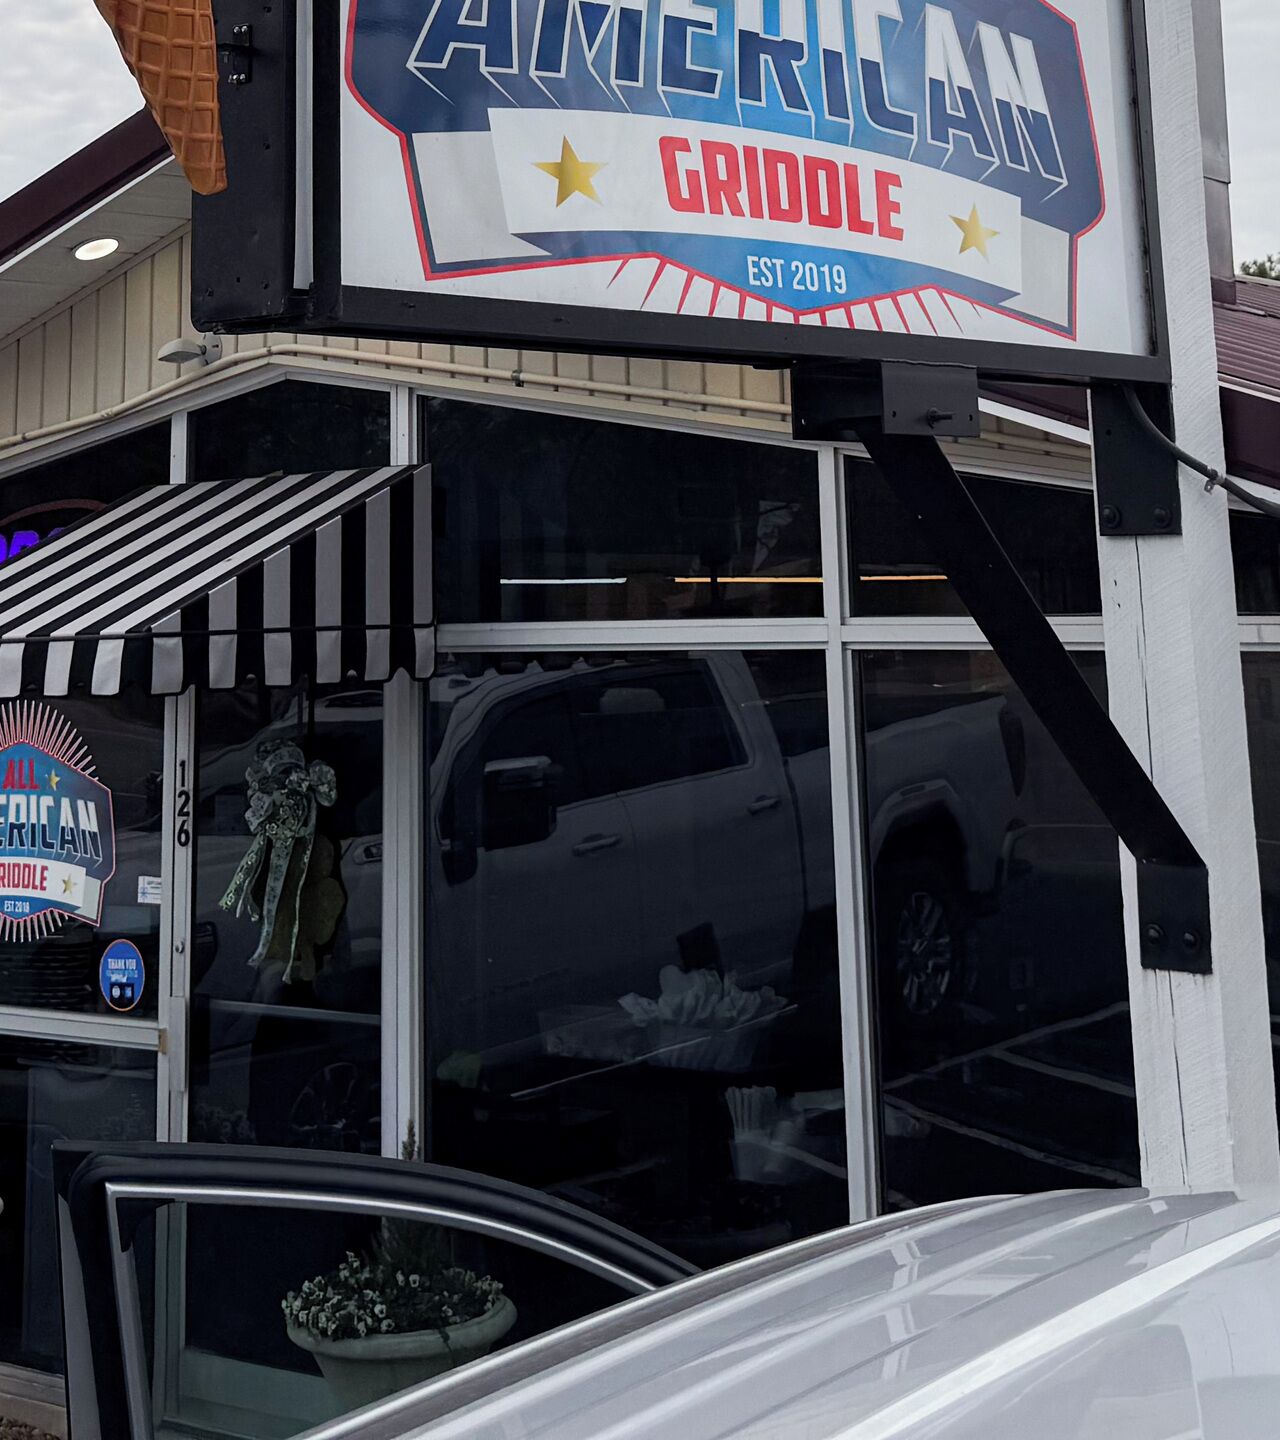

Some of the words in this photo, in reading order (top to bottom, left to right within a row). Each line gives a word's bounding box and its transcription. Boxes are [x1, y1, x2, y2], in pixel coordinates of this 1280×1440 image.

[658, 135, 904, 240] GRIDDLE
[747, 255, 783, 288] EST
[791, 261, 847, 295] 2019
[2, 758, 40, 790] ALL
